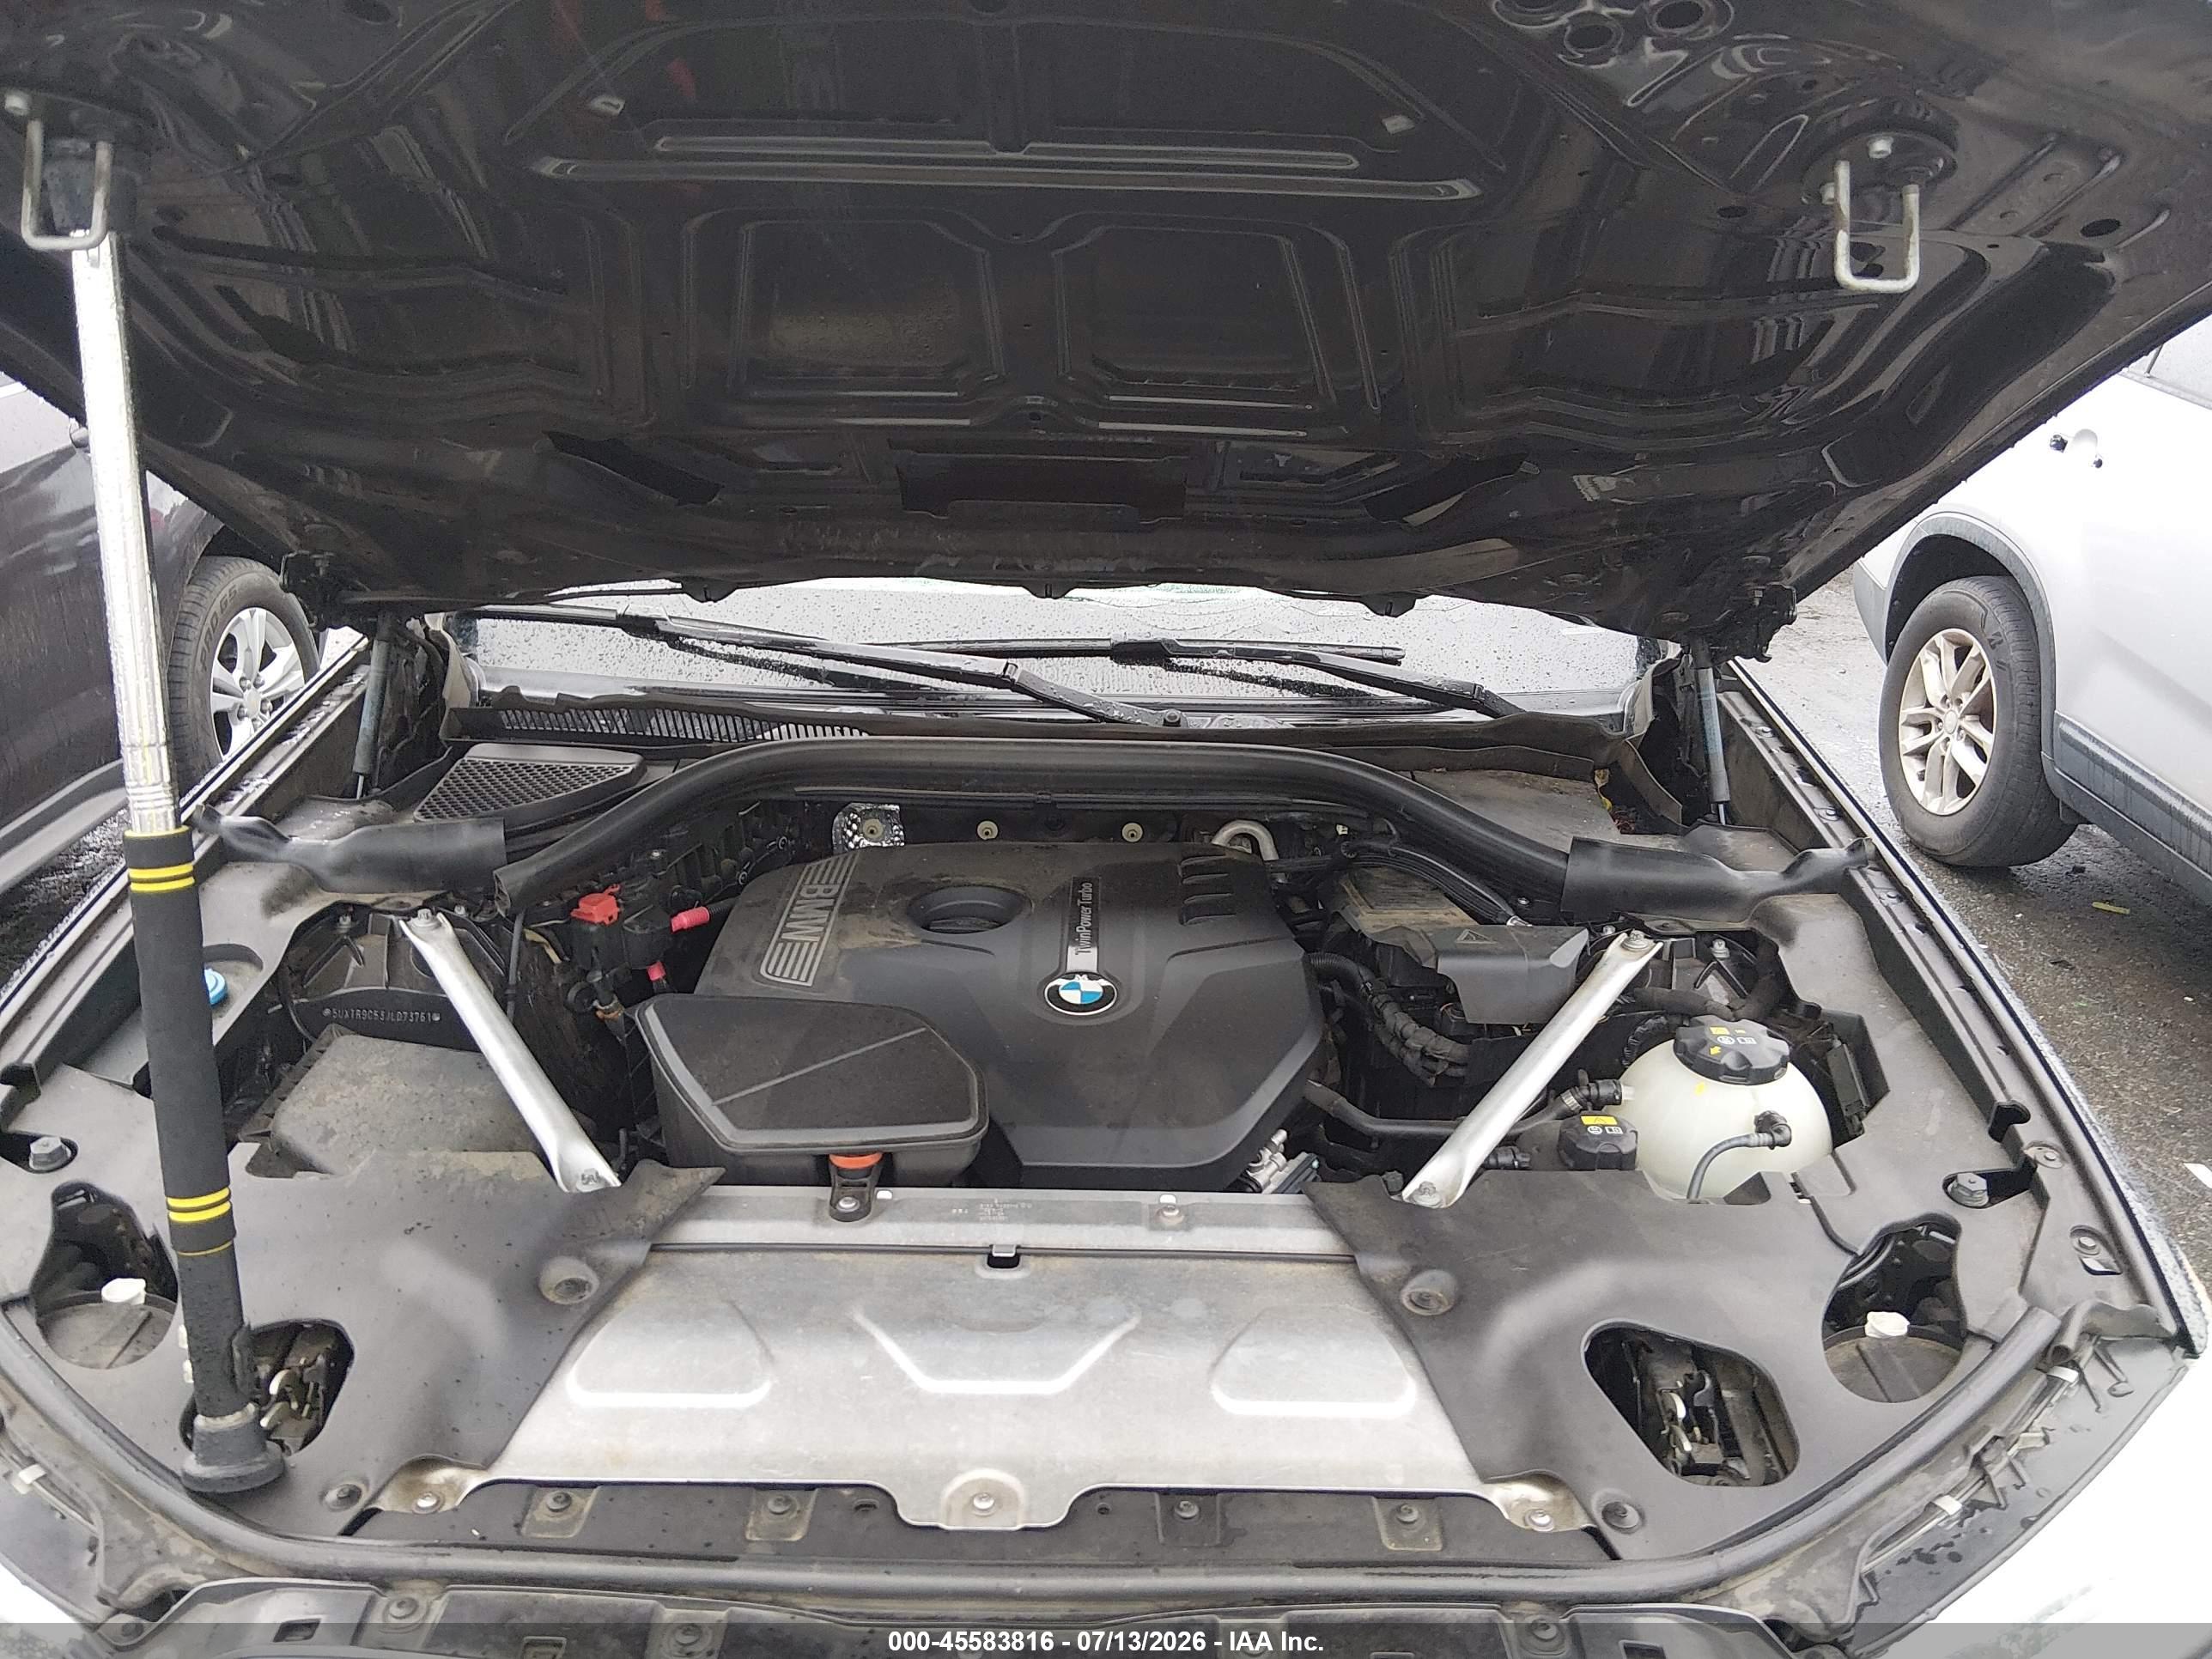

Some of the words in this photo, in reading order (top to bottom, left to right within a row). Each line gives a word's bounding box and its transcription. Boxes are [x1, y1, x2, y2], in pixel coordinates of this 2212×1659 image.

[781, 884, 842, 943] BMW
[1077, 882, 1093, 907] Turbo
[1075, 907, 1092, 956] TwinPower
